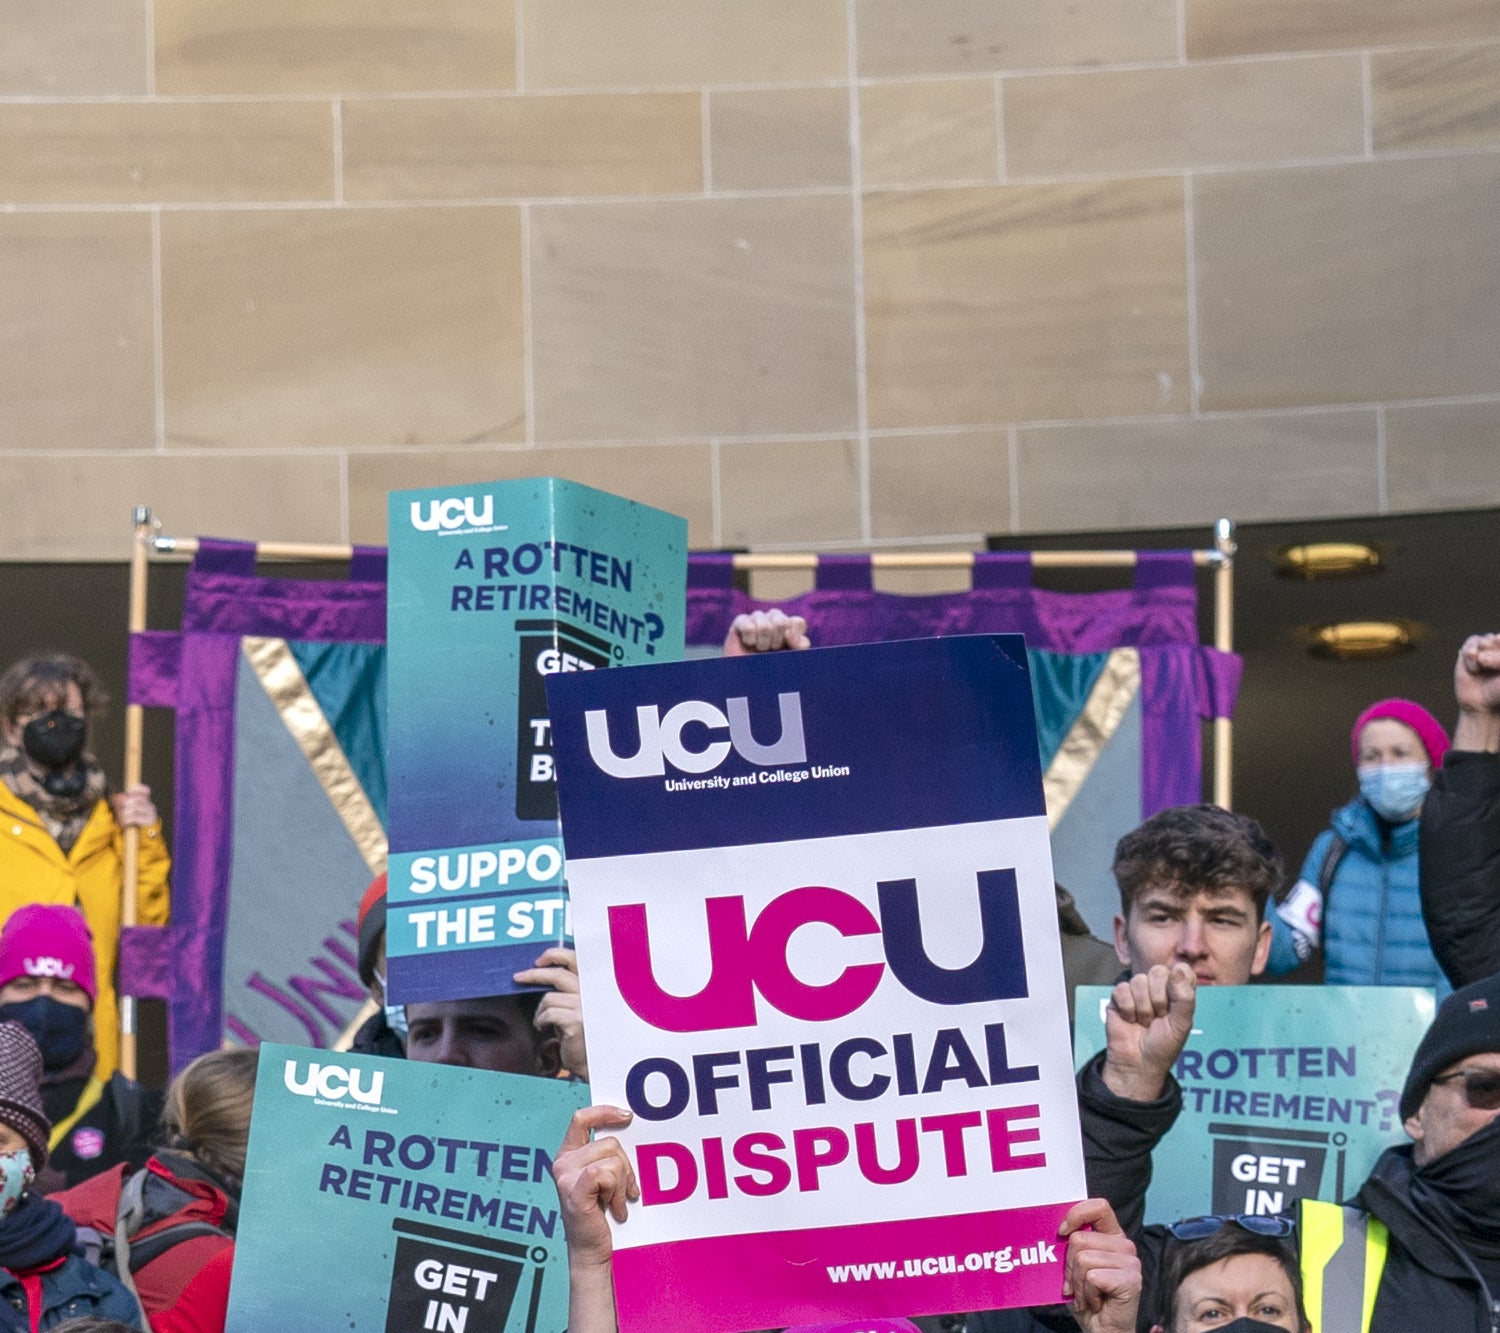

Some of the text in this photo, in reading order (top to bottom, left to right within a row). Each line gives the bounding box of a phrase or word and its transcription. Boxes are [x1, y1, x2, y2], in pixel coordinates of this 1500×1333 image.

[410, 494, 494, 532] UCU
[455, 541, 633, 593] A ROTTEN
[451, 584, 665, 656] RETIREMENT?
[585, 690, 807, 779] UCU
[665, 764, 850, 792] University and College Union
[410, 844, 562, 895] SUPPO
[409, 902, 496, 950] THE
[607, 867, 1029, 1033] UCU
[284, 1060, 384, 1105] UCU
[624, 1022, 1040, 1123] OFFICIAL
[1177, 1045, 1357, 1081] ROTTEN
[328, 1124, 556, 1184] A ROTTEN
[636, 1103, 1048, 1209] DISPUTE
[1231, 1153, 1306, 1186] GET
[1244, 1189, 1284, 1215] IN
[413, 1258, 498, 1301] GET
[826, 1240, 1060, 1286] www.ucu.org.uk
